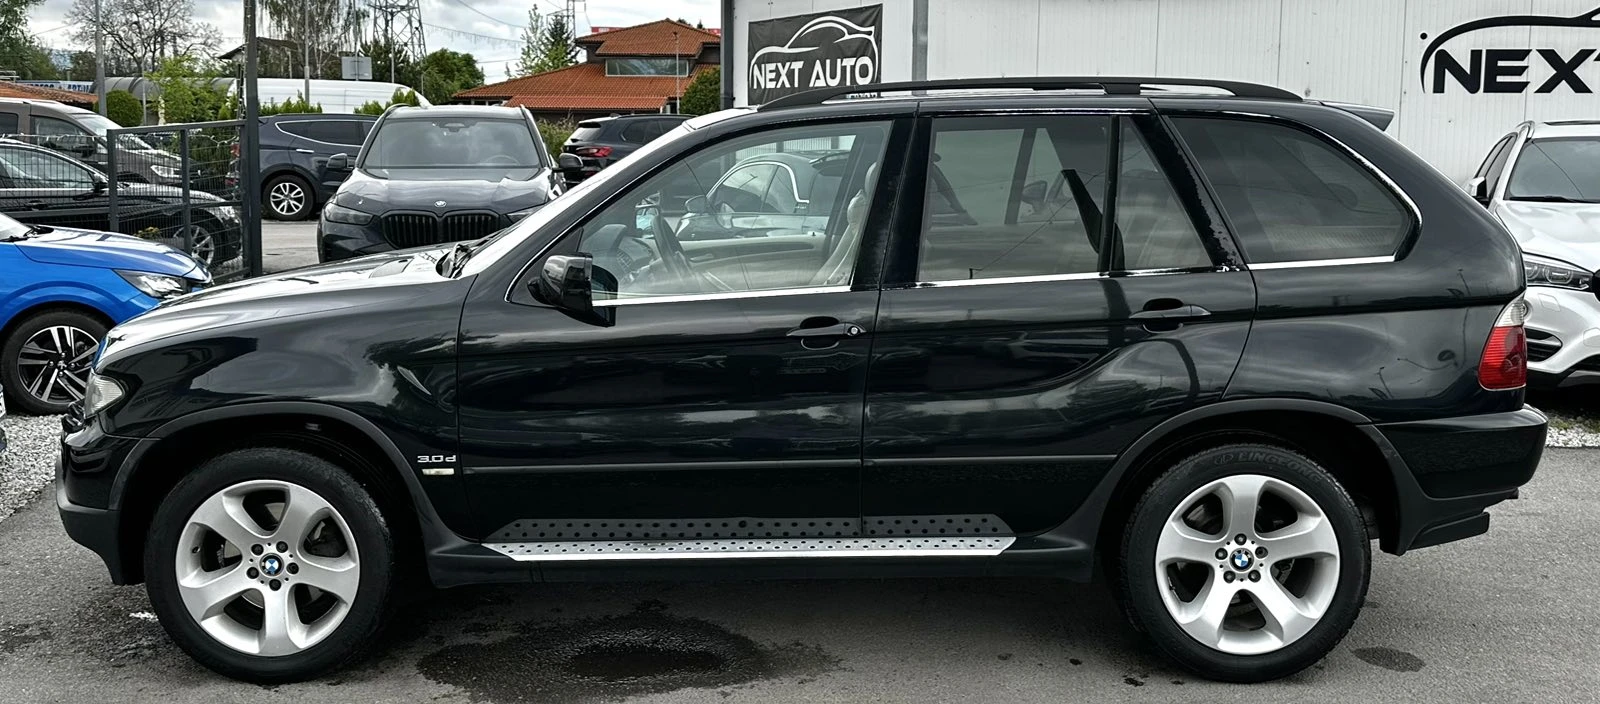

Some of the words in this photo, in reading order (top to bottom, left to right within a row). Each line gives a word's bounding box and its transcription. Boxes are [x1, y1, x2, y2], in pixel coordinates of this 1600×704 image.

[753, 61, 804, 89] NEXT
[809, 56, 874, 87] AUTO
[1432, 48, 1600, 94] NEX
[417, 455, 457, 463] 3.0d
